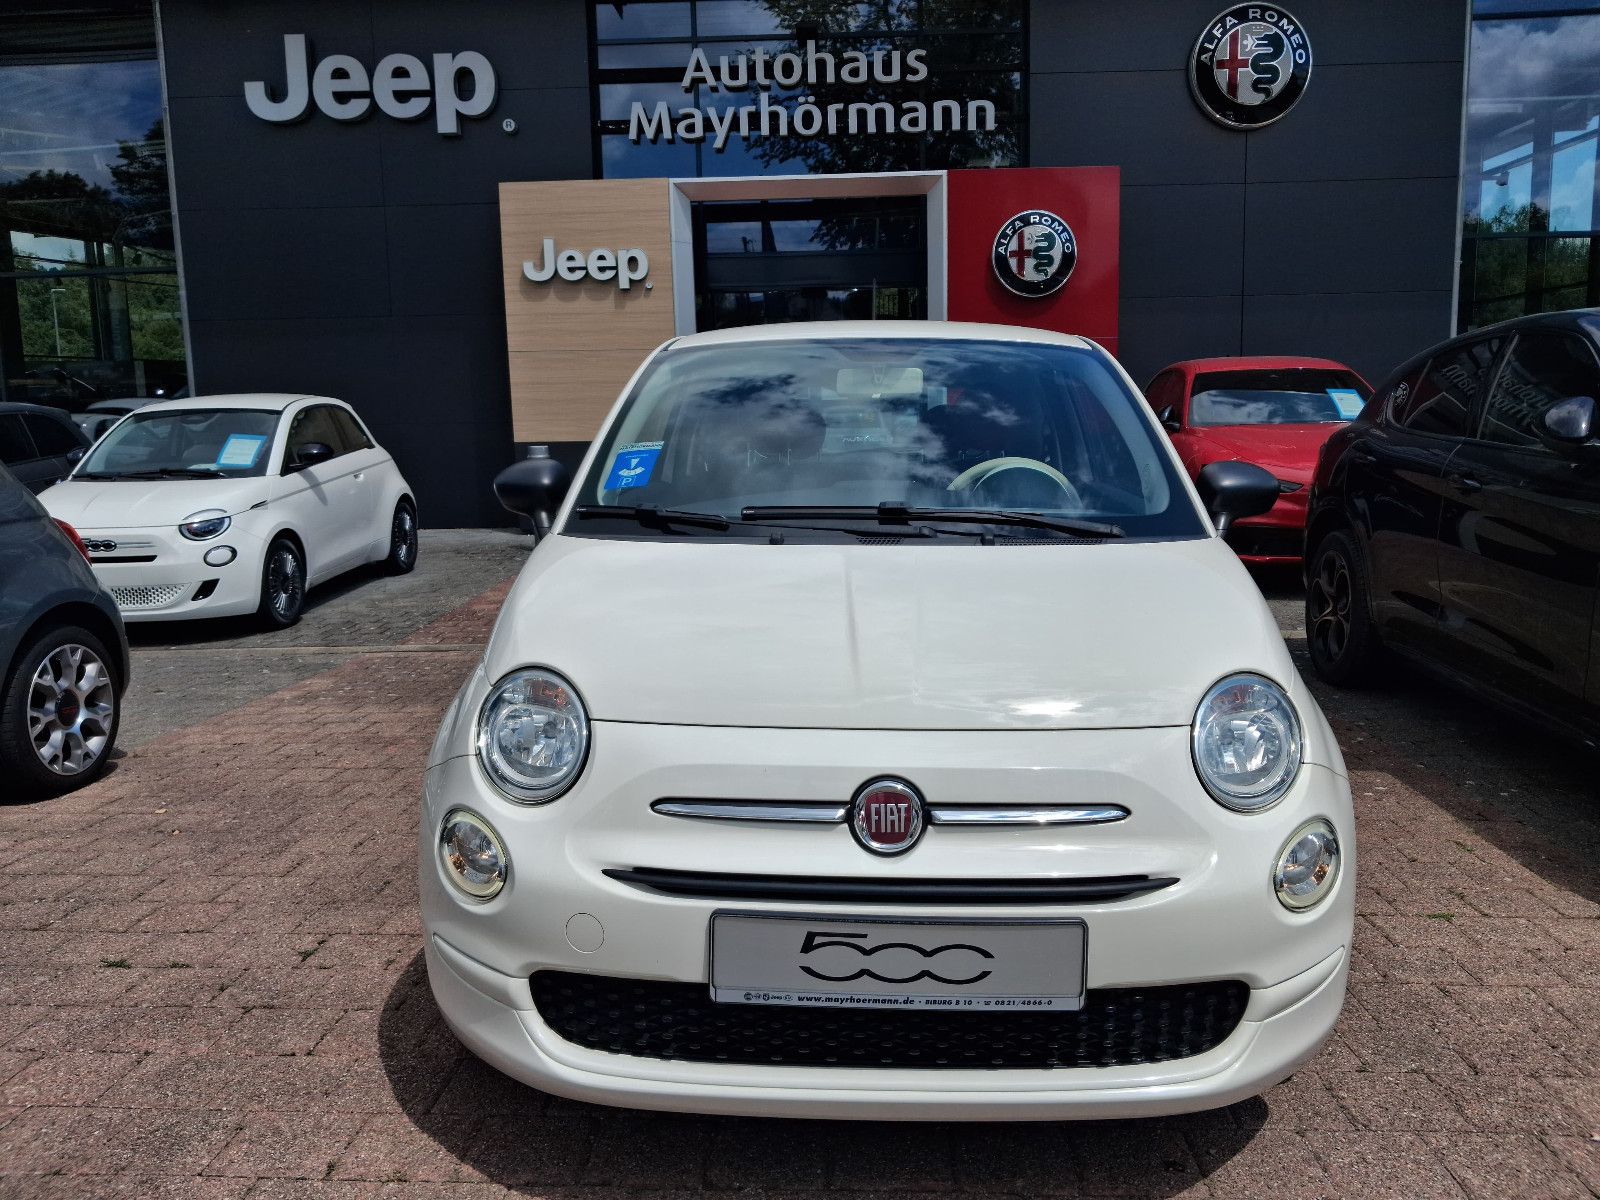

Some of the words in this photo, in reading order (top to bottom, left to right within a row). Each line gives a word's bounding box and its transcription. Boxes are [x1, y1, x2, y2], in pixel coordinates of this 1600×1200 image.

[1200, 15, 1239, 66] ALFA
[1248, 8, 1306, 64] ROMEO
[244, 33, 496, 135] Jeep
[681, 39, 928, 92] Autohaus
[628, 92, 998, 150] Mayrhörmann
[998, 220, 1024, 255] ALFA
[1030, 215, 1072, 253] ROMEO
[523, 238, 649, 289] Jeep
[870, 803, 908, 833] FIAT
[798, 930, 996, 985] 500
[797, 994, 915, 1006] www.mayrhoermann.de
[994, 999, 1053, 1007] 0821/4866-0
